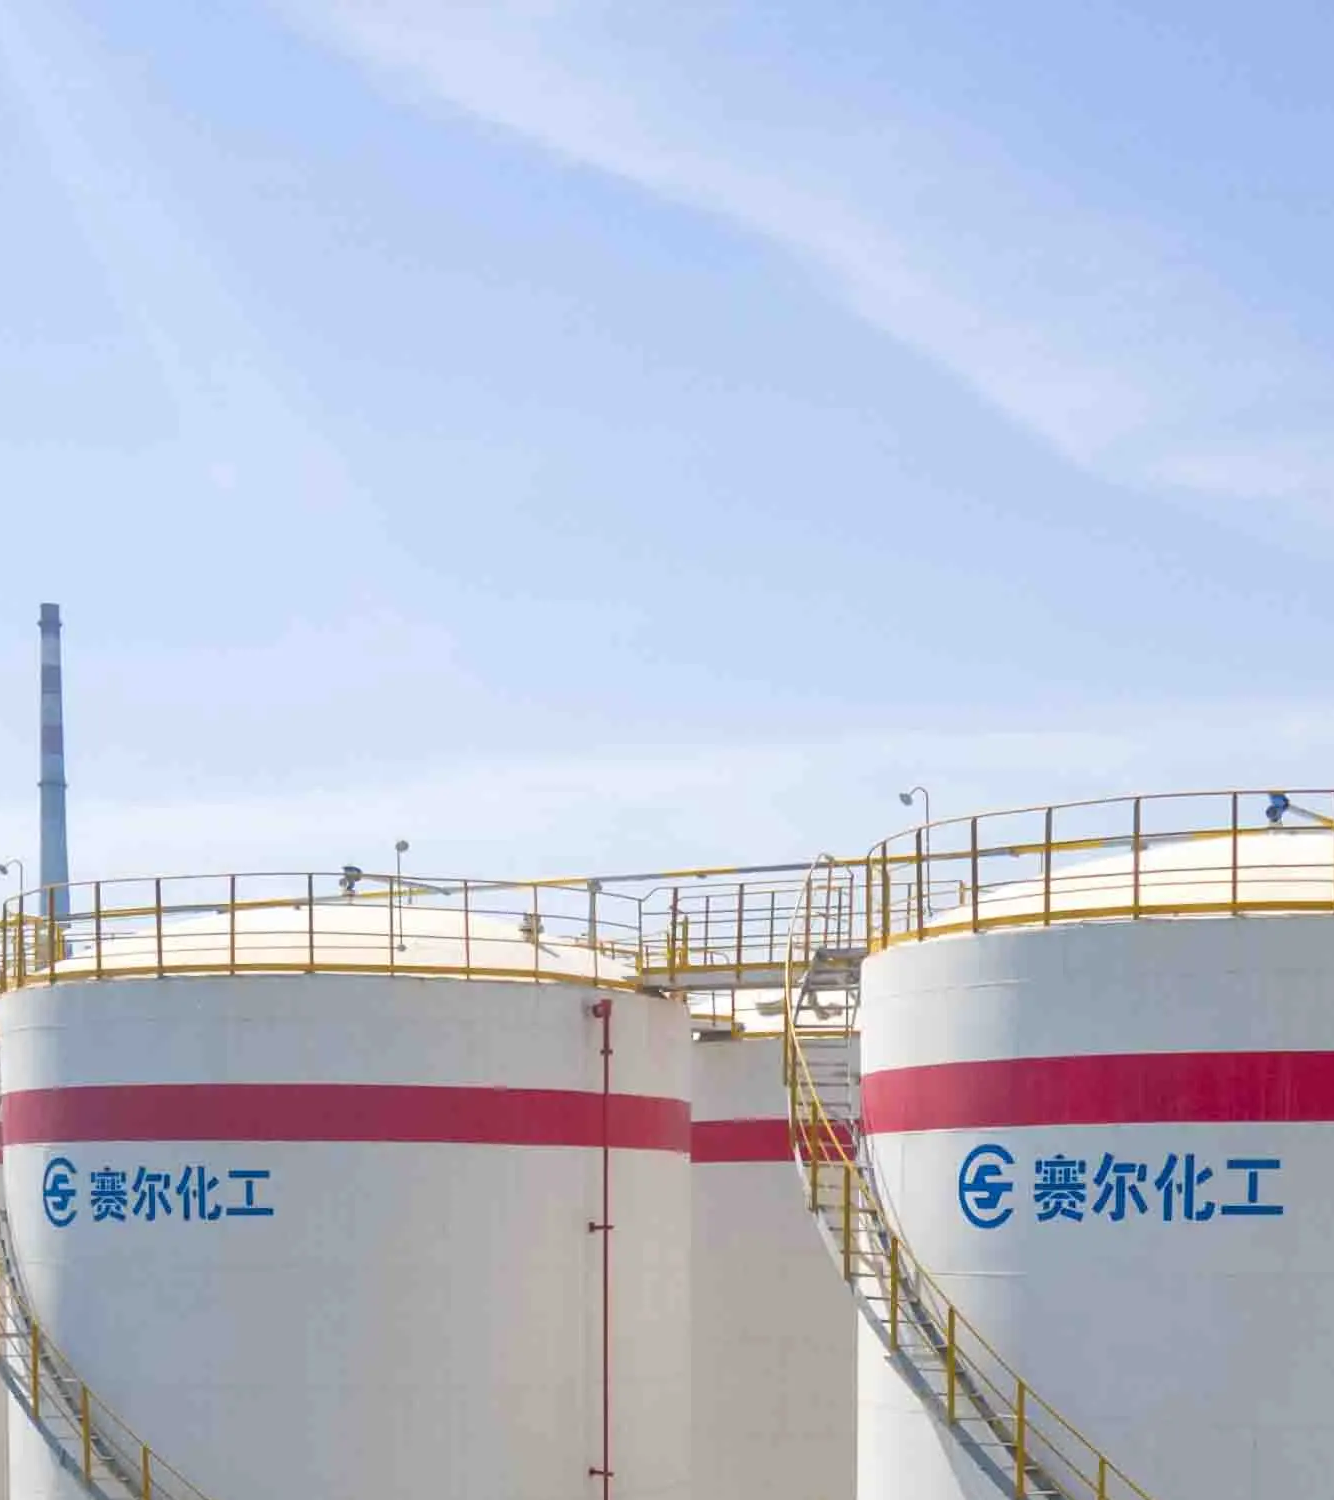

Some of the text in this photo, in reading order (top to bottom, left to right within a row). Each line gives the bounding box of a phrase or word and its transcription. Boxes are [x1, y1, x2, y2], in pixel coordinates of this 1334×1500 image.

[90, 1166, 274, 1222] 赛尔化工
[1033, 1152, 1284, 1222] 赛尔化工
